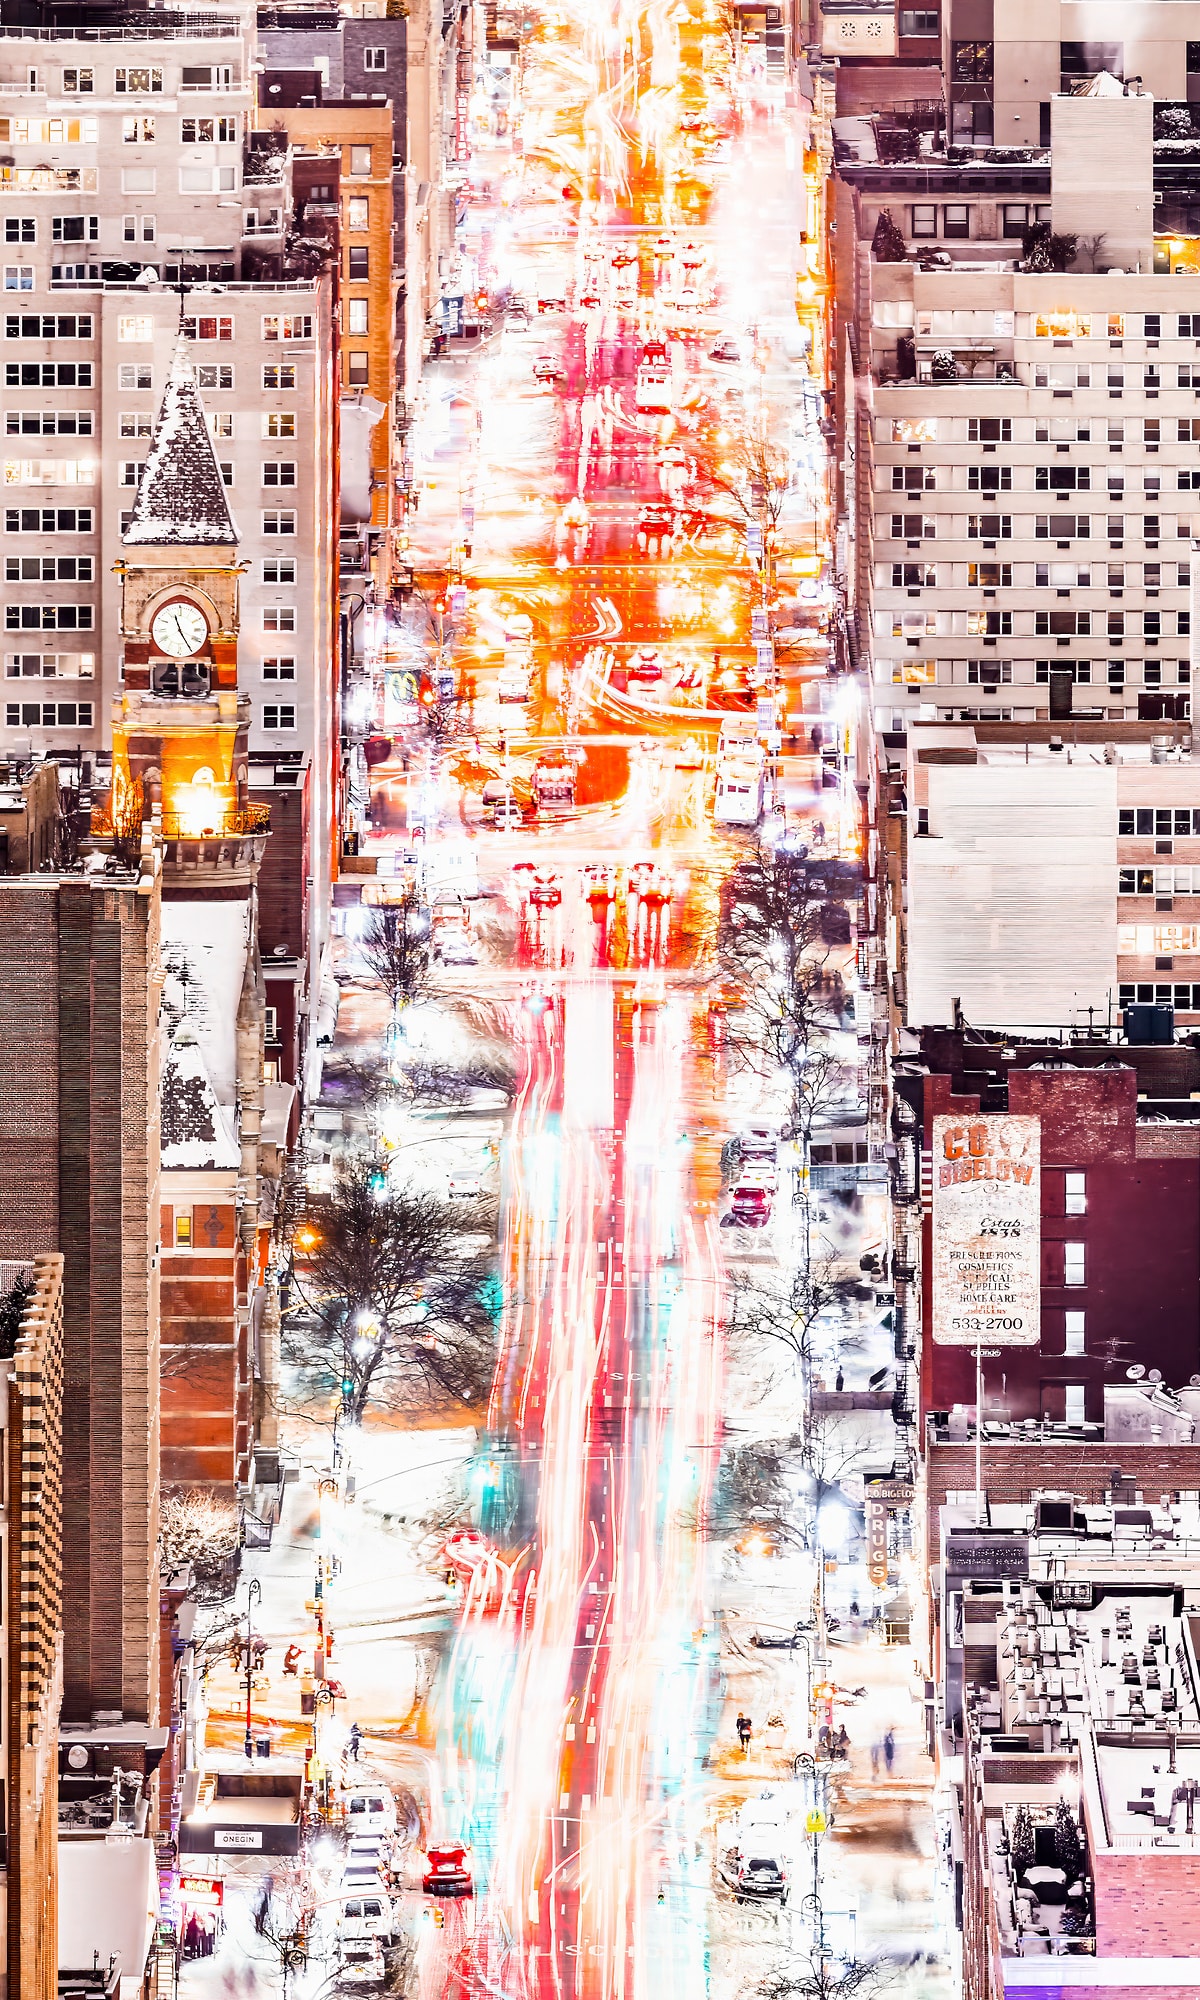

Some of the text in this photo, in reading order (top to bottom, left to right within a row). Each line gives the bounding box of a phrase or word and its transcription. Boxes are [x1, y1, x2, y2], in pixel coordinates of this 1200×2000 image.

[939, 1158, 1035, 1189] BIGELOW
[980, 1228, 1021, 1238] 1838
[958, 1262, 1014, 1271] COSMETICS
[989, 1294, 1017, 1303] CARE
[952, 1317, 1023, 1331] 533-2700
[872, 1503, 885, 1577] DRUGS
